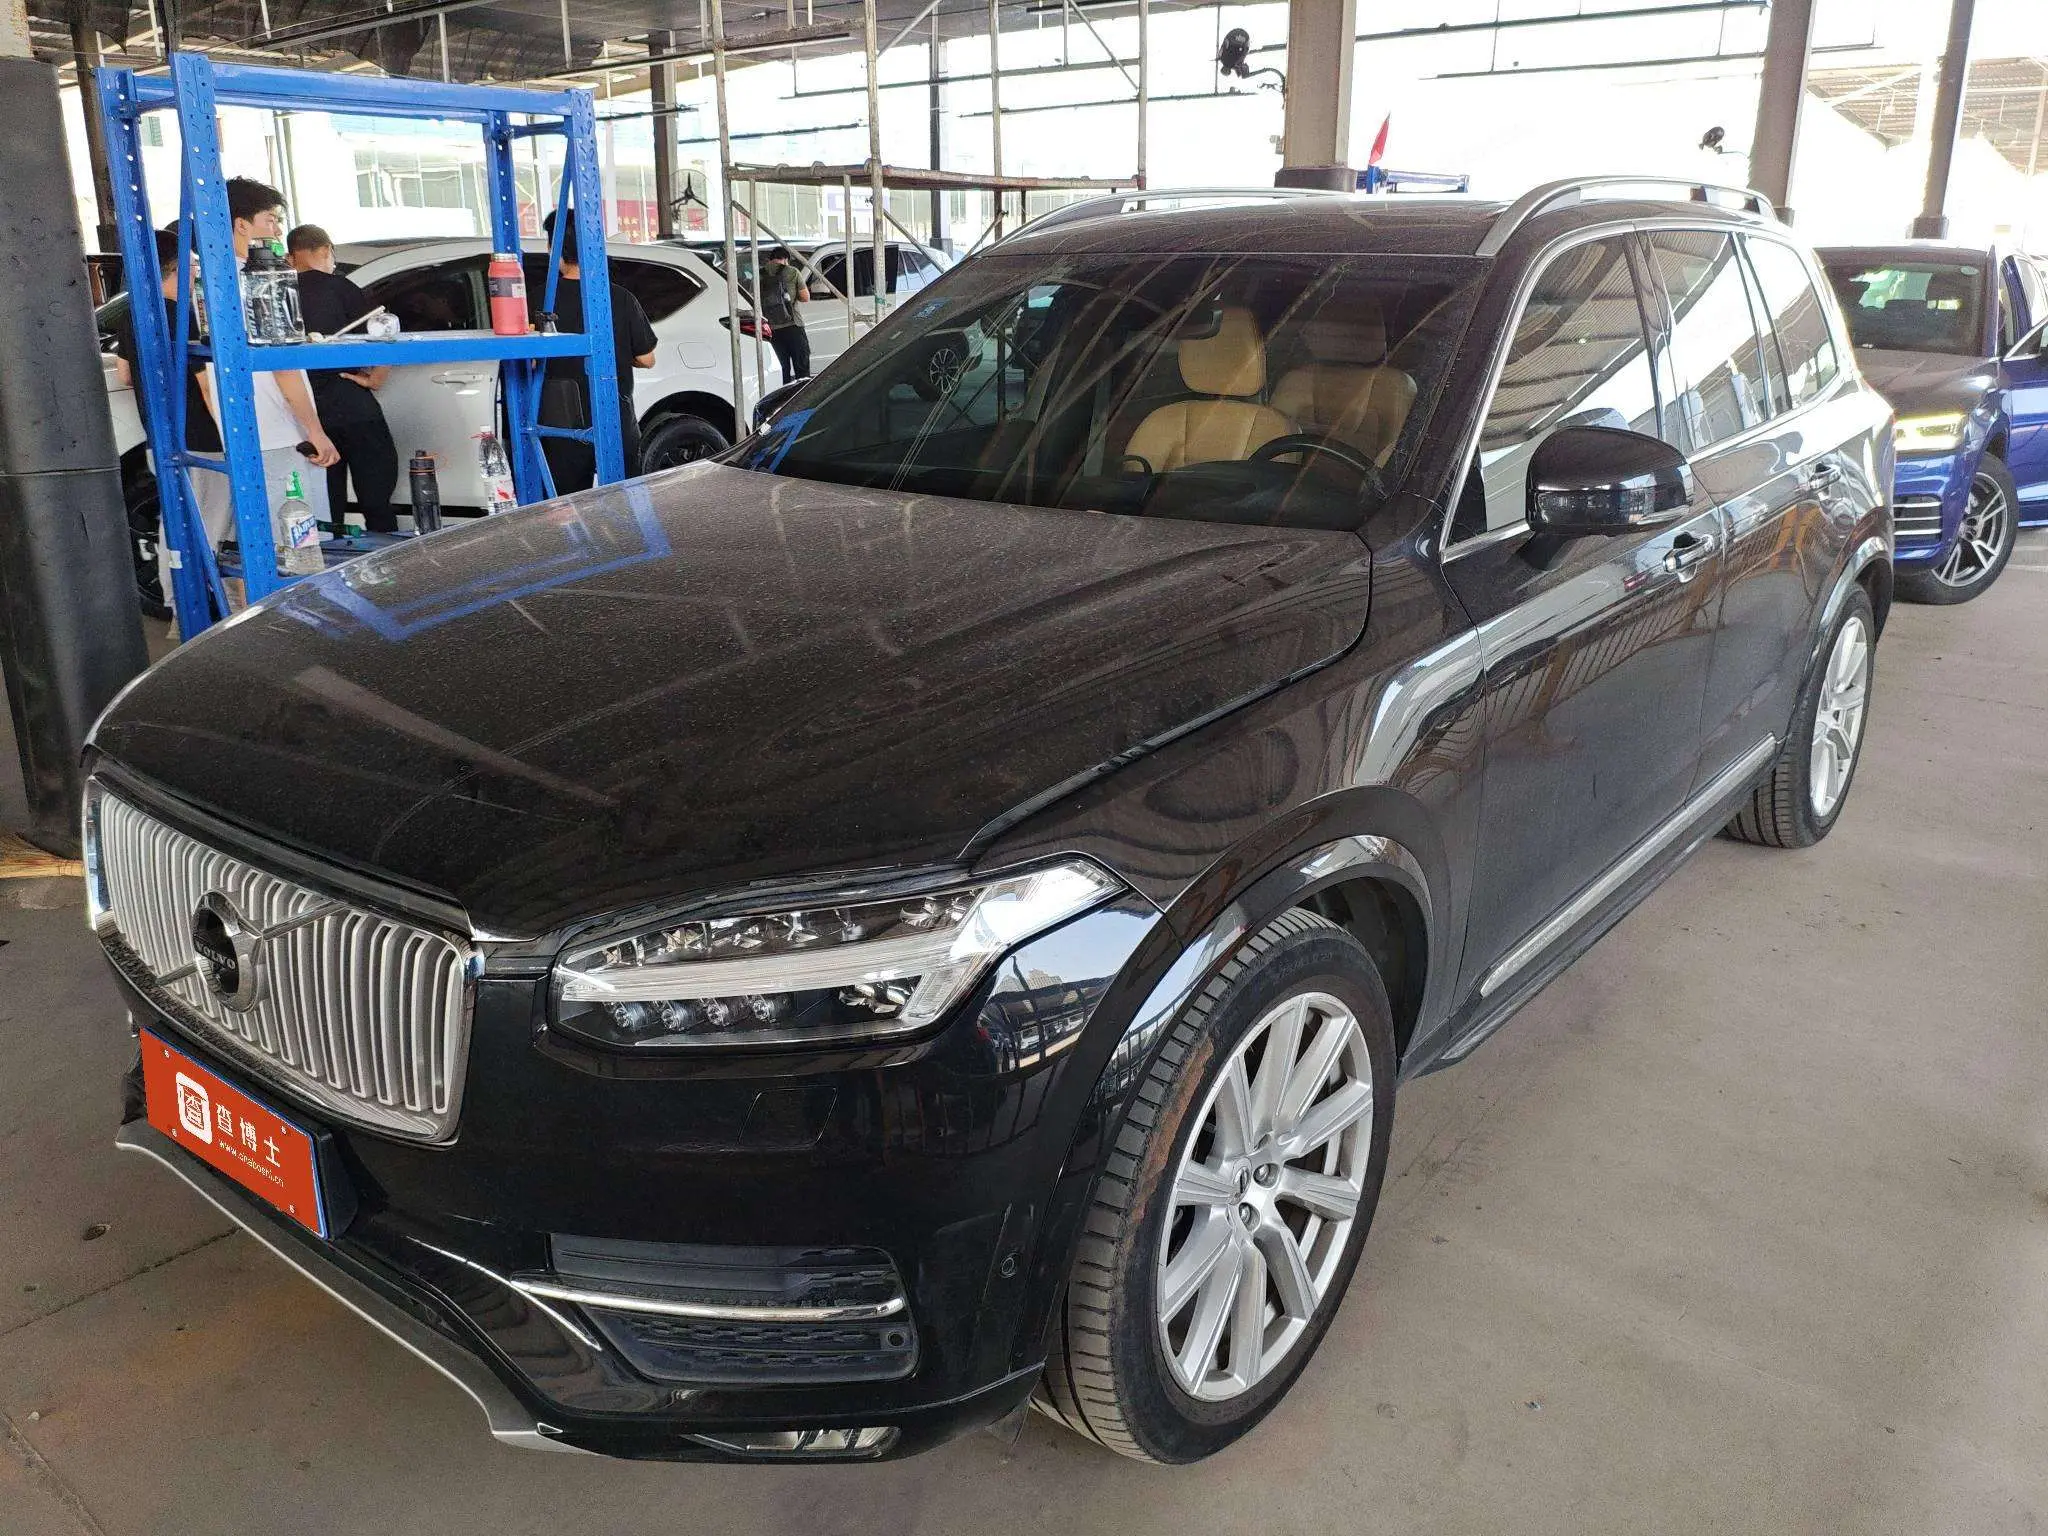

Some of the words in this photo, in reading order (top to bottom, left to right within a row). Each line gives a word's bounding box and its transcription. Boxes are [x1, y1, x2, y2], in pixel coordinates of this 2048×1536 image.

[194, 940, 236, 970] VOLVO
[216, 1103, 281, 1168] 查博士
